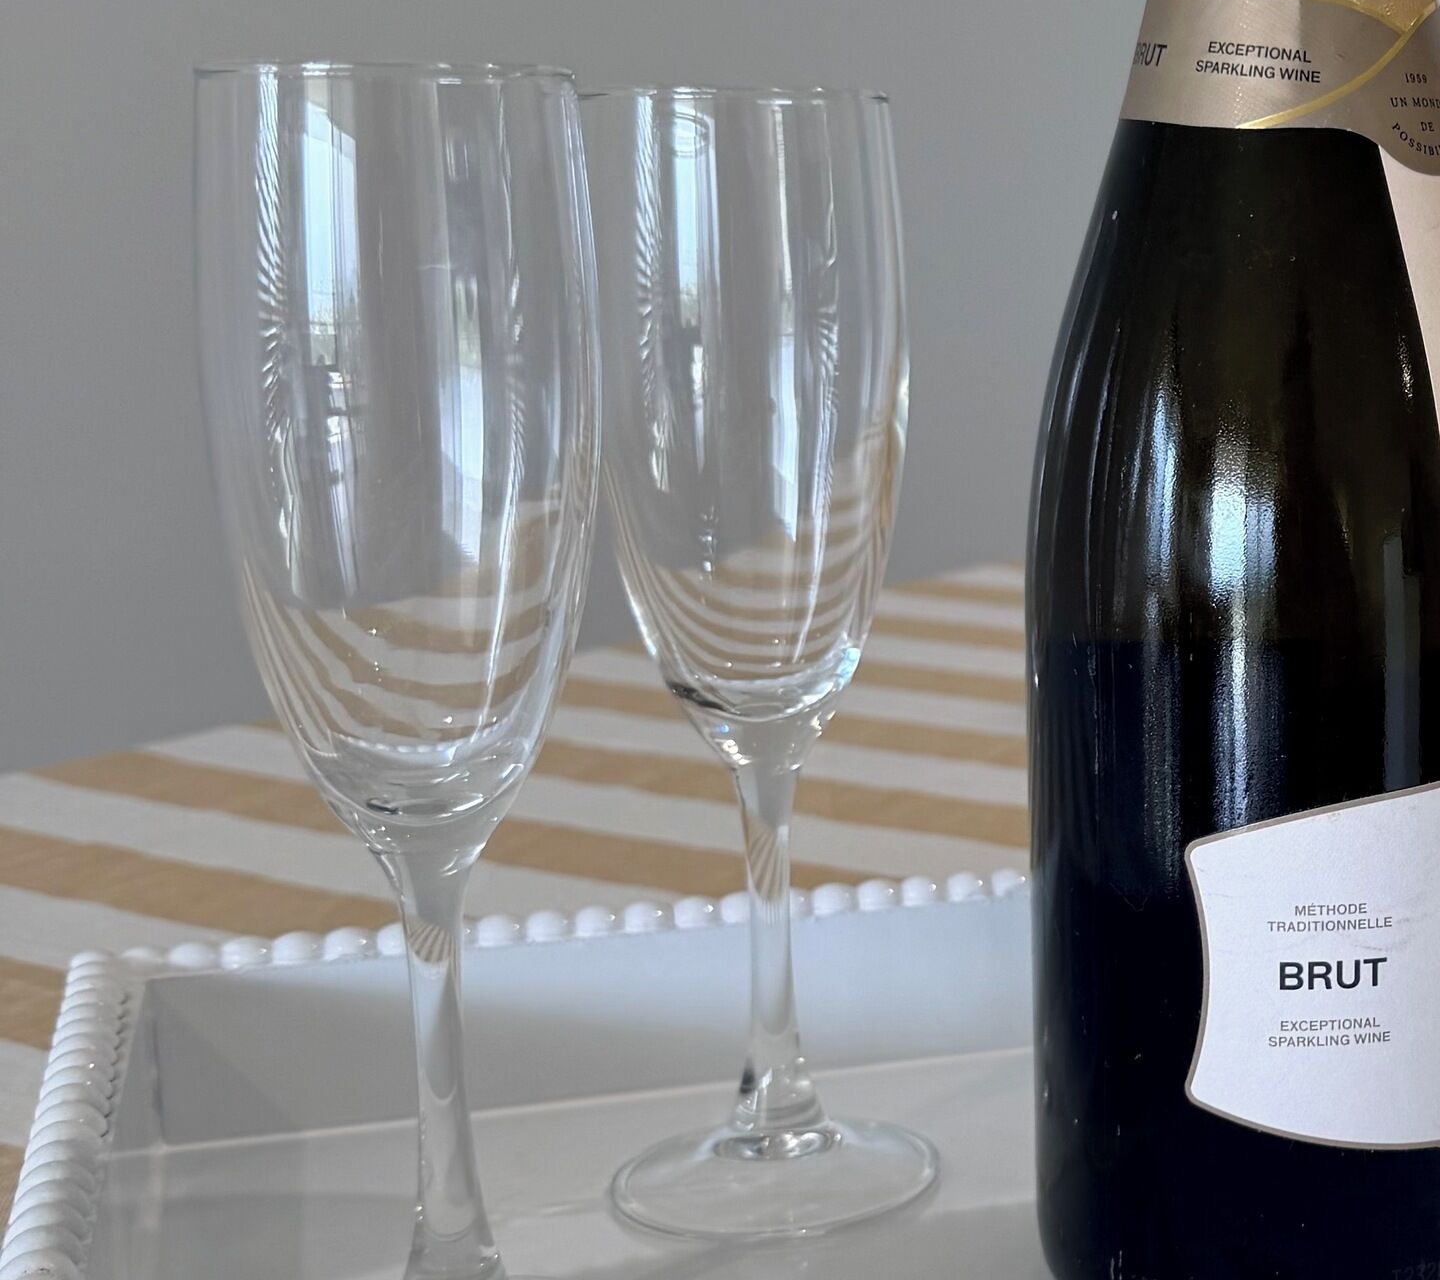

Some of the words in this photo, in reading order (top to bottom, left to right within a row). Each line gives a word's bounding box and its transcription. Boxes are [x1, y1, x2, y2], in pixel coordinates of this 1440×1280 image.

[1207, 41, 1312, 64] EXCEPTIONAL
[1195, 59, 1277, 80] SPARKLING
[1279, 66, 1321, 84] WINE
[1405, 72, 1428, 84] 1959
[1390, 96, 1408, 108] UN
[1420, 121, 1435, 132] DE
[1294, 902, 1368, 917] MÉTHODE
[1267, 916, 1393, 932] TRADITIONNELLE
[1278, 957, 1388, 991] BRUT
[1280, 1017, 1381, 1032] EXCEPTIONAL
[1268, 1032, 1351, 1047] SPARKLING
[1354, 1031, 1391, 1045] WINE
